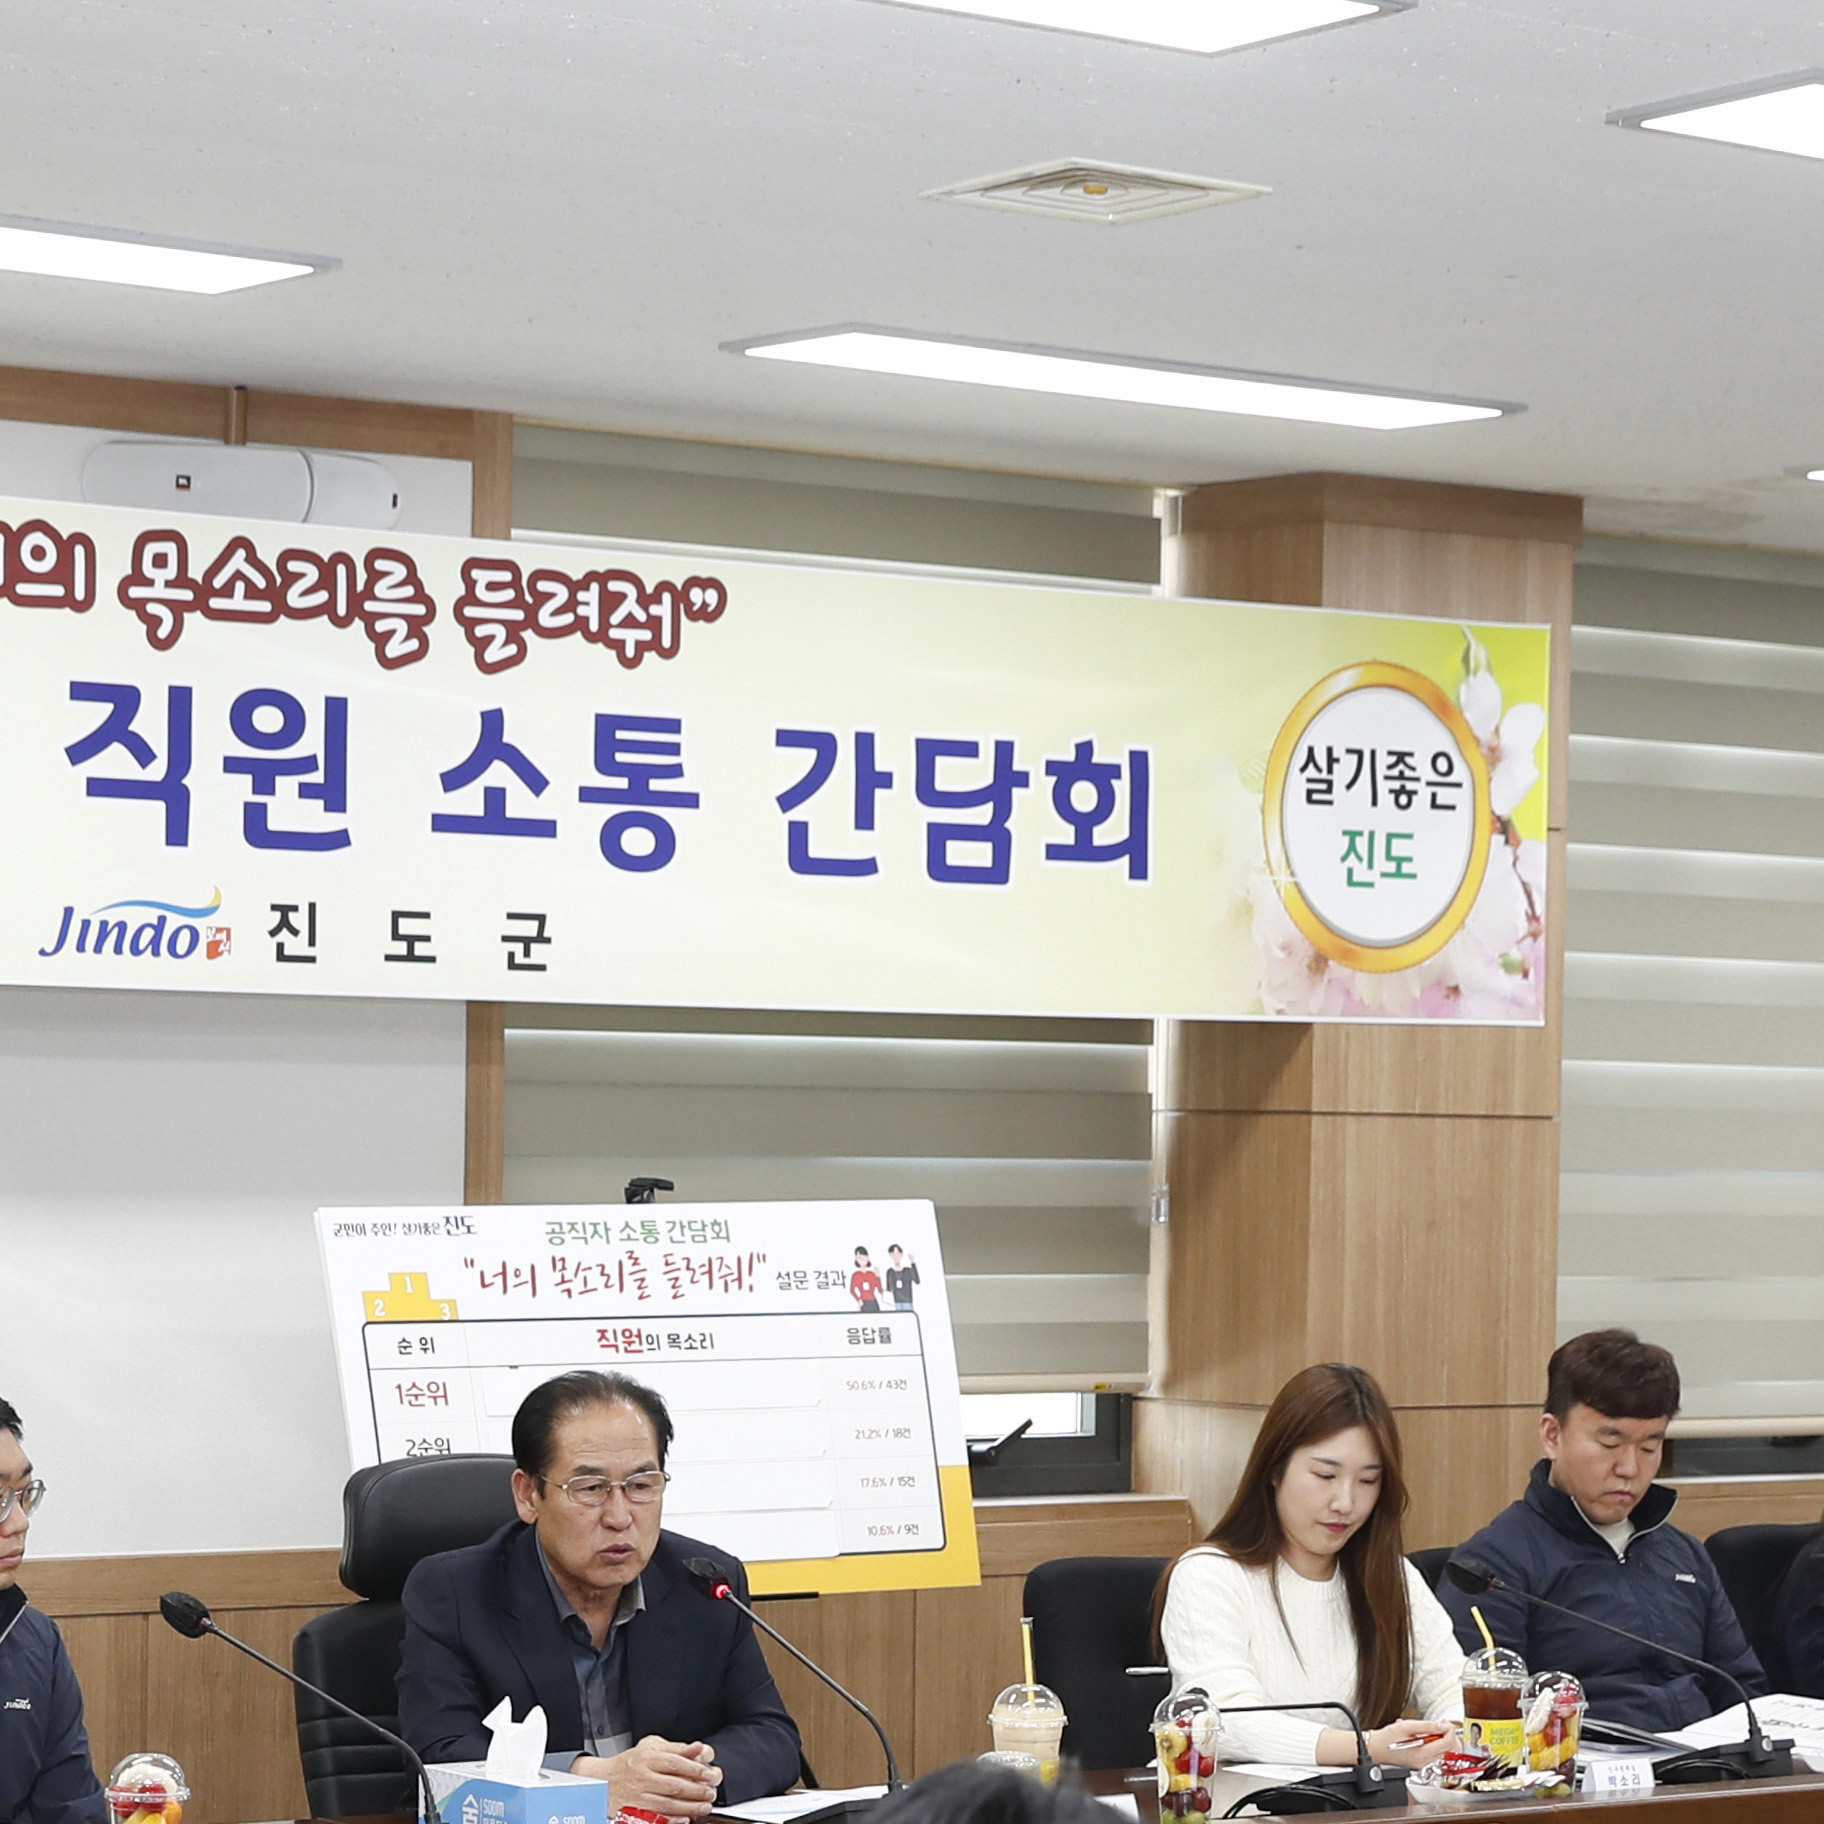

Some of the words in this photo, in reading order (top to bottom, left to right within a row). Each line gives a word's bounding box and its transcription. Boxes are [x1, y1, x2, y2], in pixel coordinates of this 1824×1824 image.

[121, 533, 433, 666] 목소리를
[64, 679, 353, 853] 직원
[430, 707, 701, 873] 소통
[775, 726, 1151, 887] 간담회
[1298, 744, 1465, 814] 살기좋은
[1337, 828, 1419, 889] 진도
[37, 905, 201, 960] Jindo
[332, 1222, 367, 1237] 군민이
[370, 1222, 398, 1237] 주인!
[442, 1215, 478, 1236] 진도
[545, 1221, 611, 1247] 공직자
[619, 1220, 661, 1246] 소통
[666, 1218, 732, 1245] 간담회
[403, 1275, 415, 1294] 1
[551, 1250, 652, 1301] 목소리를
[775, 1270, 810, 1292] 설문
[813, 1268, 848, 1291] 결과
[372, 1299, 387, 1318] 2
[439, 1302, 452, 1321] 3
[595, 1327, 662, 1355] 직원의
[666, 1331, 716, 1351] 목소리
[846, 1326, 893, 1346] 응답률
[394, 1380, 450, 1408] 1순위
